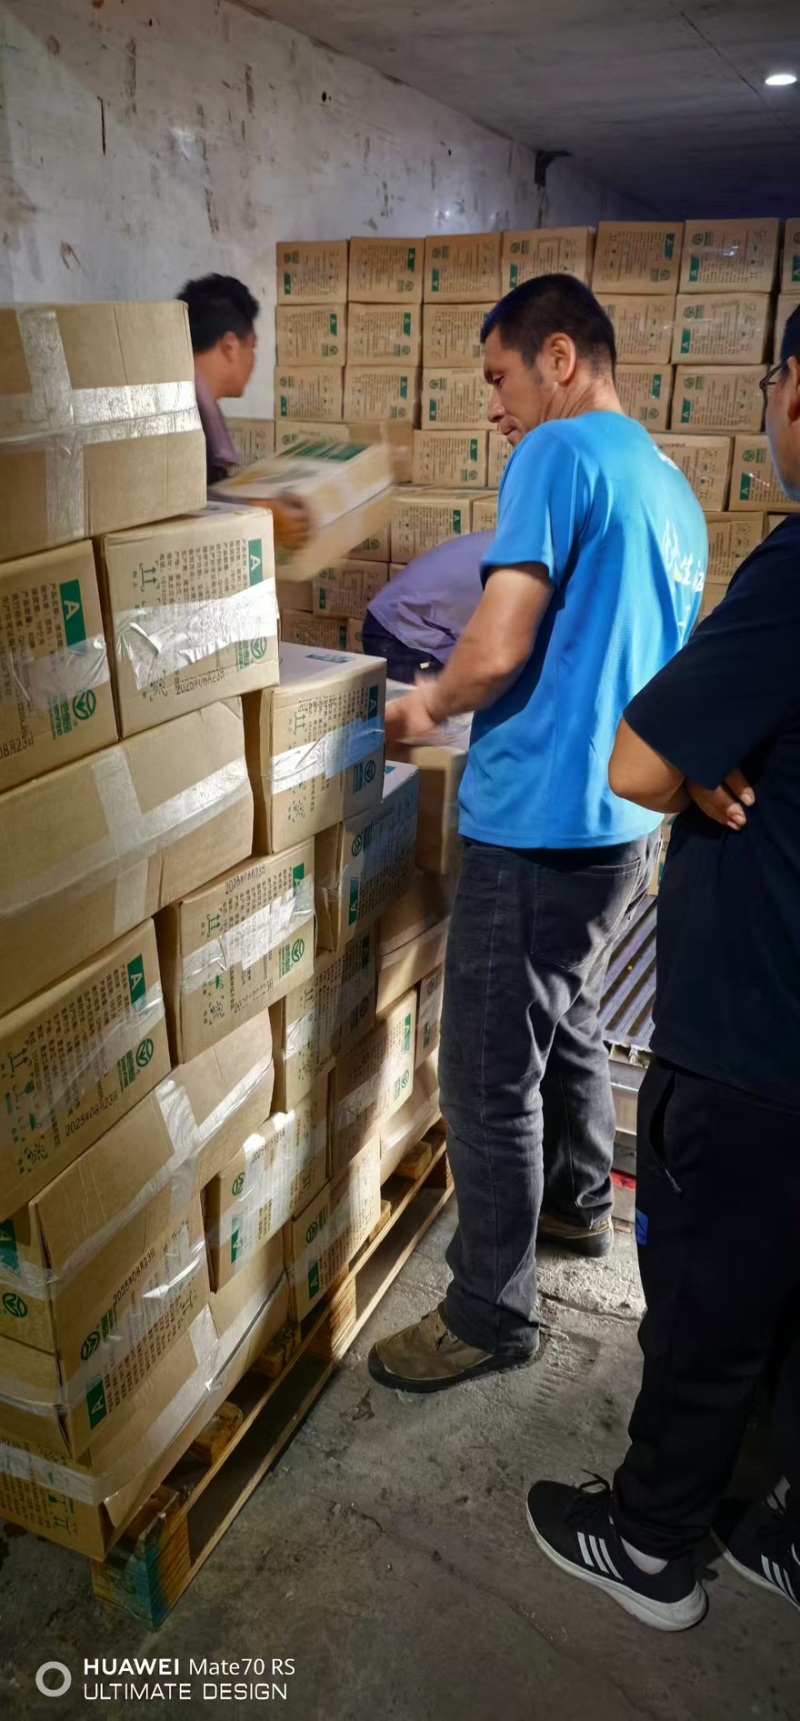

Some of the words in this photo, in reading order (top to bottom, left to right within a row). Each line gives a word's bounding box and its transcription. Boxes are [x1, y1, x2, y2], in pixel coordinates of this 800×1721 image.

[251, 554, 261, 572] A
[63, 599, 80, 620] A
[129, 972, 143, 991] A
[112, 1247, 156, 1302] 2025年08月23日
[91, 1396, 104, 1414] A
